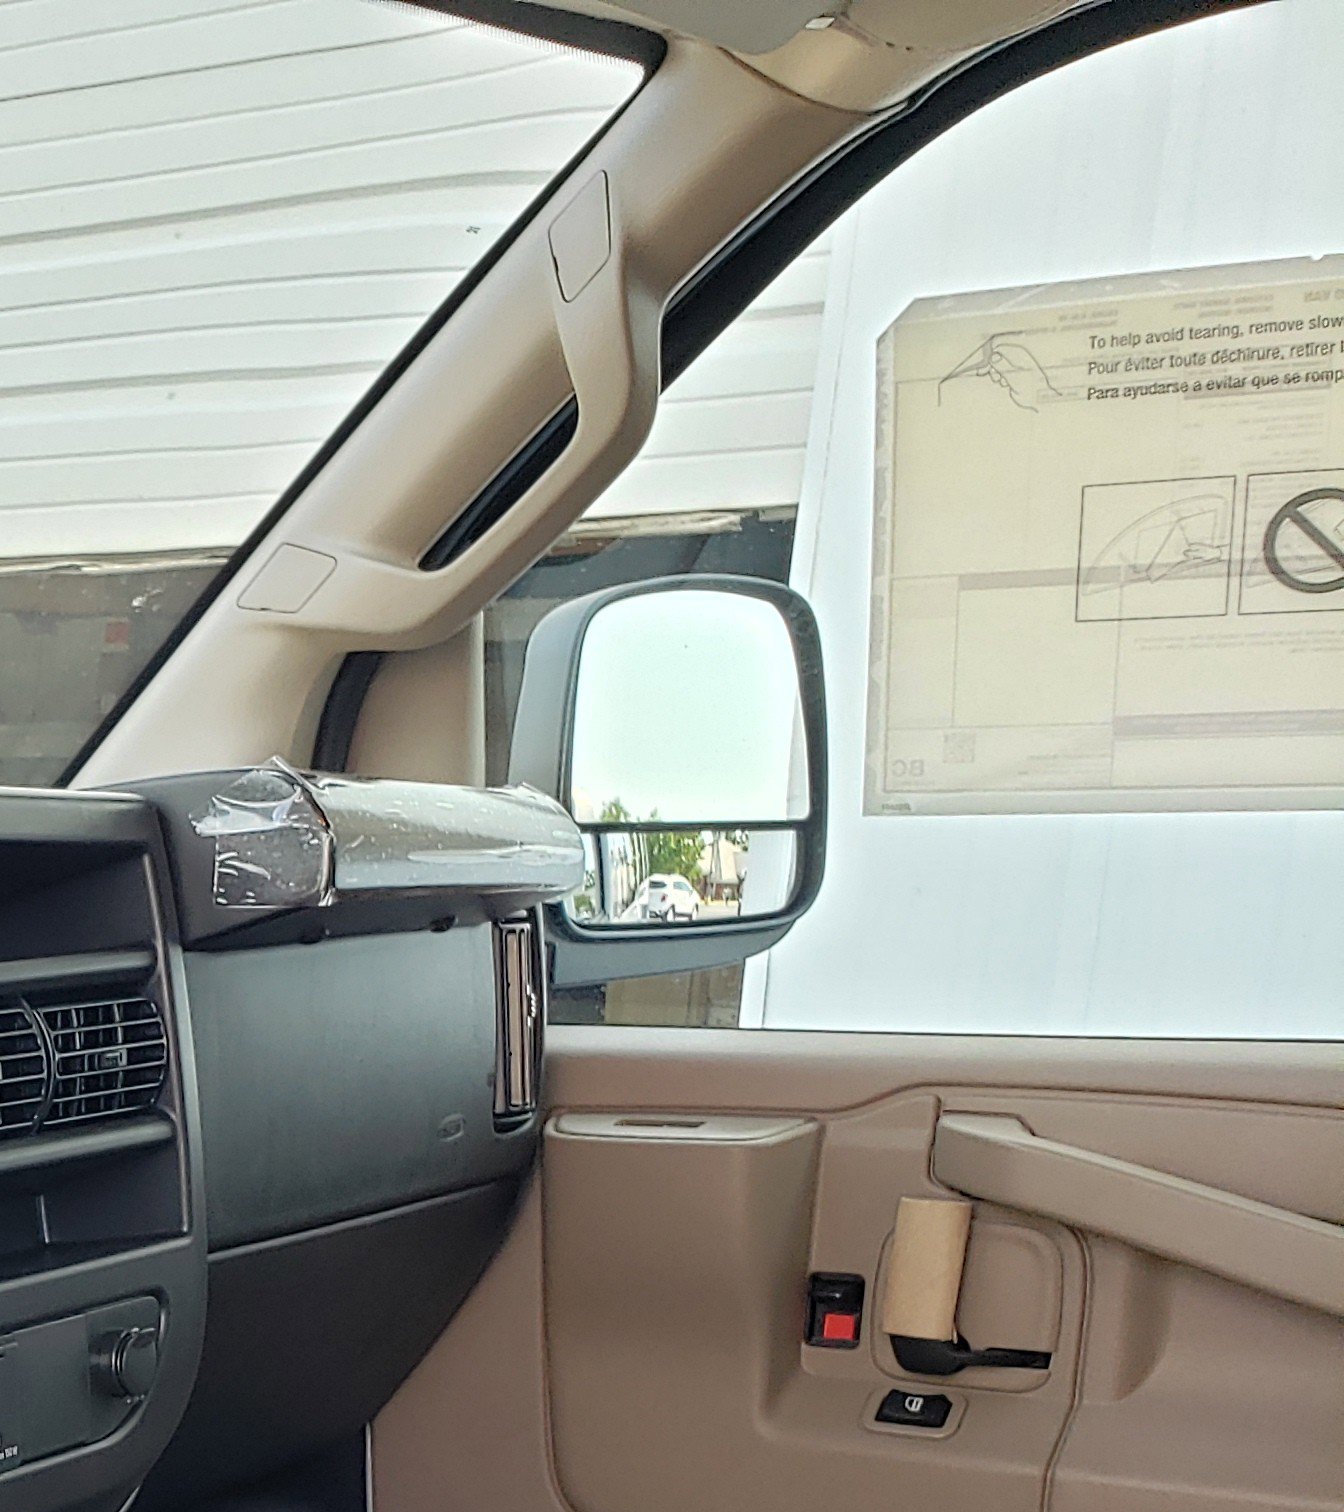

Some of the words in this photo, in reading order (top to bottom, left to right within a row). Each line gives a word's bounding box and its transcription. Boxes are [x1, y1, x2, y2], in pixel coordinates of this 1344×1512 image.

[1089, 335, 1106, 350] To
[1110, 332, 1141, 349] help
[1145, 327, 1184, 344] avoid
[1189, 323, 1244, 343] tearing,
[1249, 318, 1304, 335] remove
[1088, 360, 1120, 376] Pour
[1124, 355, 1165, 372] éviter
[1169, 351, 1206, 368] toute
[1211, 346, 1285, 366] déchirure,
[1290, 341, 1336, 358] retirer
[1087, 386, 1119, 401] Para
[1123, 380, 1189, 400] ayudarse
[1193, 380, 1202, 392] a
[1206, 374, 1246, 391] evitar
[1252, 374, 1279, 390] que
[1283, 372, 1301, 384] se
[1305, 368, 1344, 384] romp
